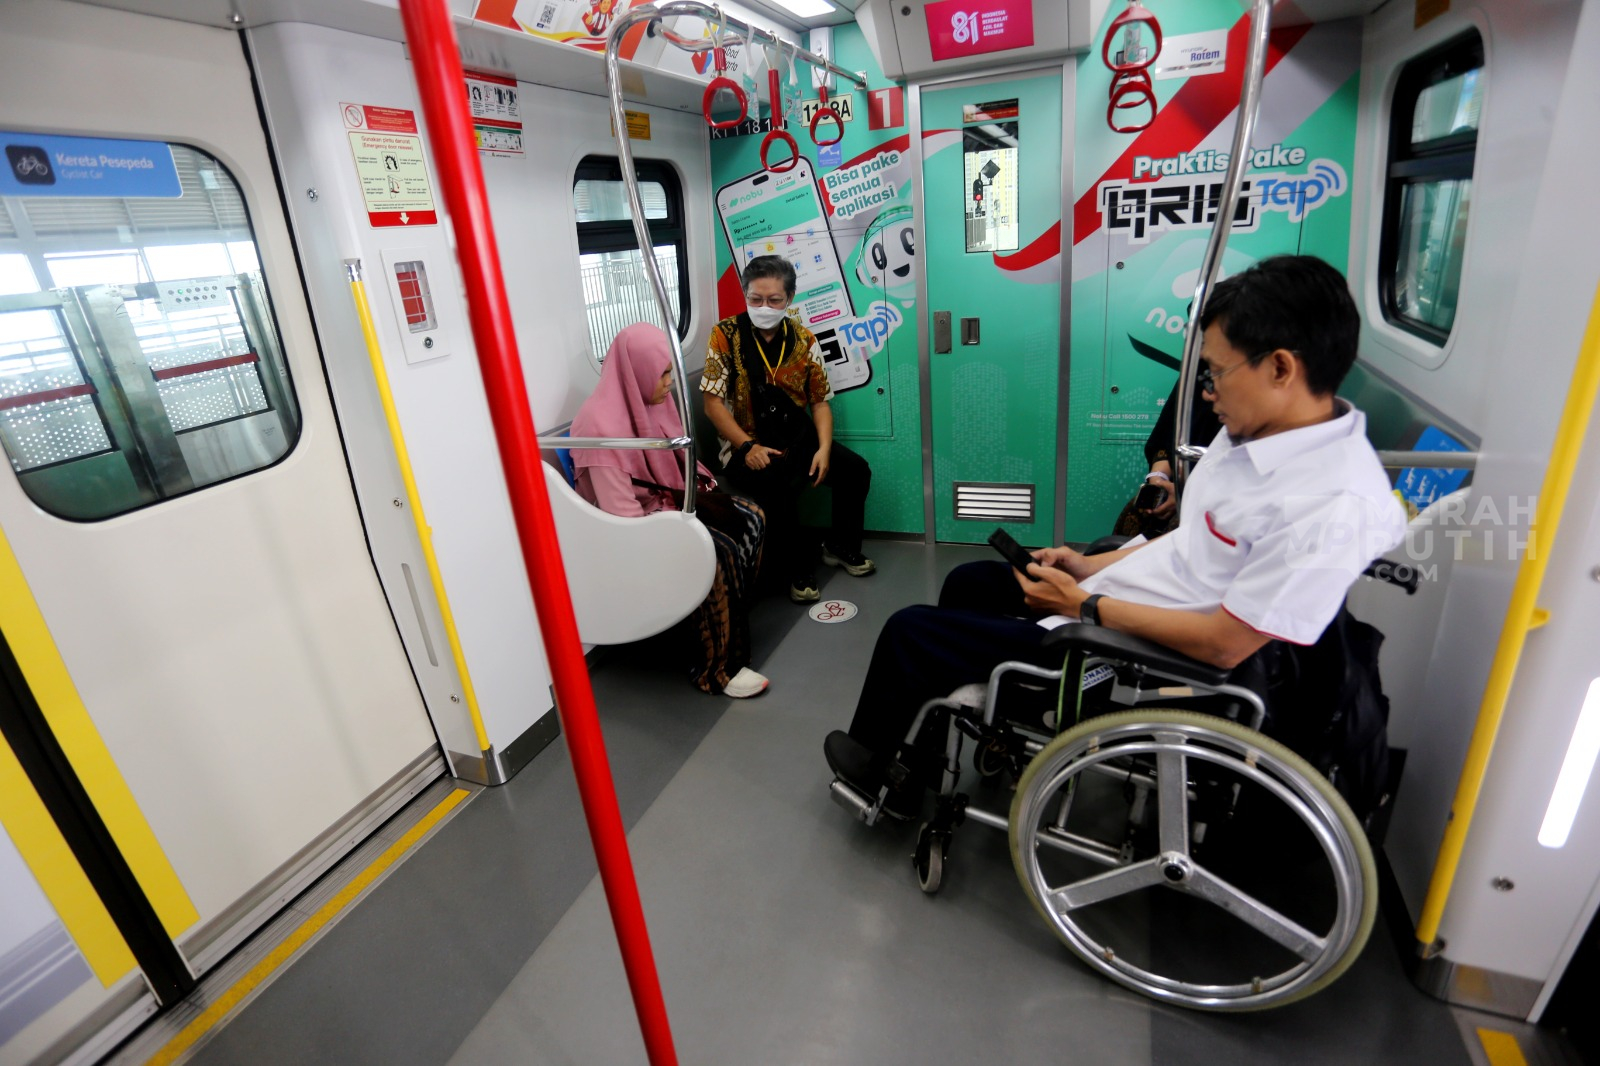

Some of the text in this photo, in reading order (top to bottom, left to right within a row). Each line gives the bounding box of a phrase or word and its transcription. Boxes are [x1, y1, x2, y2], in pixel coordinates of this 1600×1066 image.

[951, 11, 979, 45] 81
[1190, 49, 1220, 61] Rotem
[876, 89, 891, 127] 1
[56, 153, 154, 170] Kereta Pesepeda
[826, 153, 899, 189] Bisa pake
[1134, 150, 1230, 178] Praktis
[740, 189, 763, 203] nobu
[831, 177, 881, 203] semua
[837, 185, 895, 217] aplikasi
[1256, 179, 1325, 216] Tap
[839, 317, 888, 347] Tap
